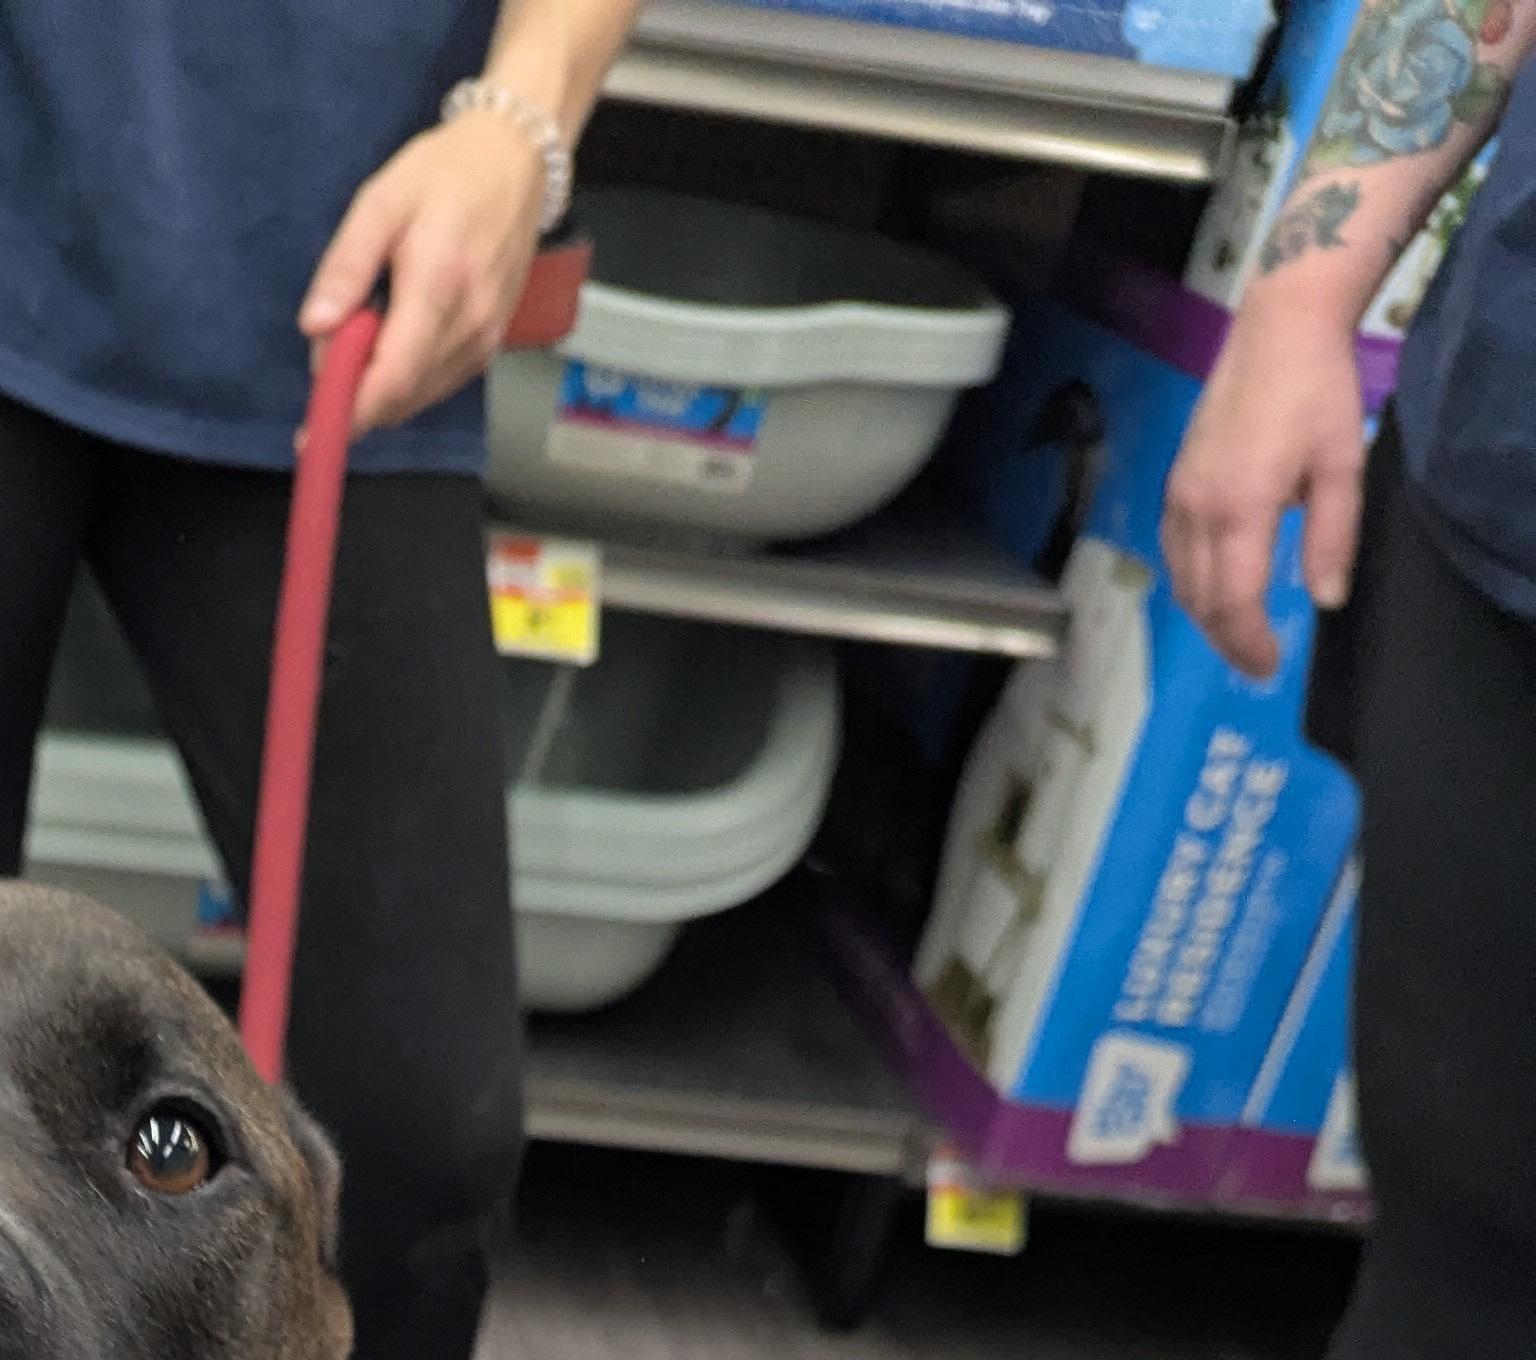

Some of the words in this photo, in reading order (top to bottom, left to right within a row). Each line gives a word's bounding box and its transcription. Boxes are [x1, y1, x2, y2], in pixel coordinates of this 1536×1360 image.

[1112, 831, 1207, 1021] LUXURY
[1184, 727, 1251, 833] CAT
[1156, 758, 1288, 1027] RESIDENCE
